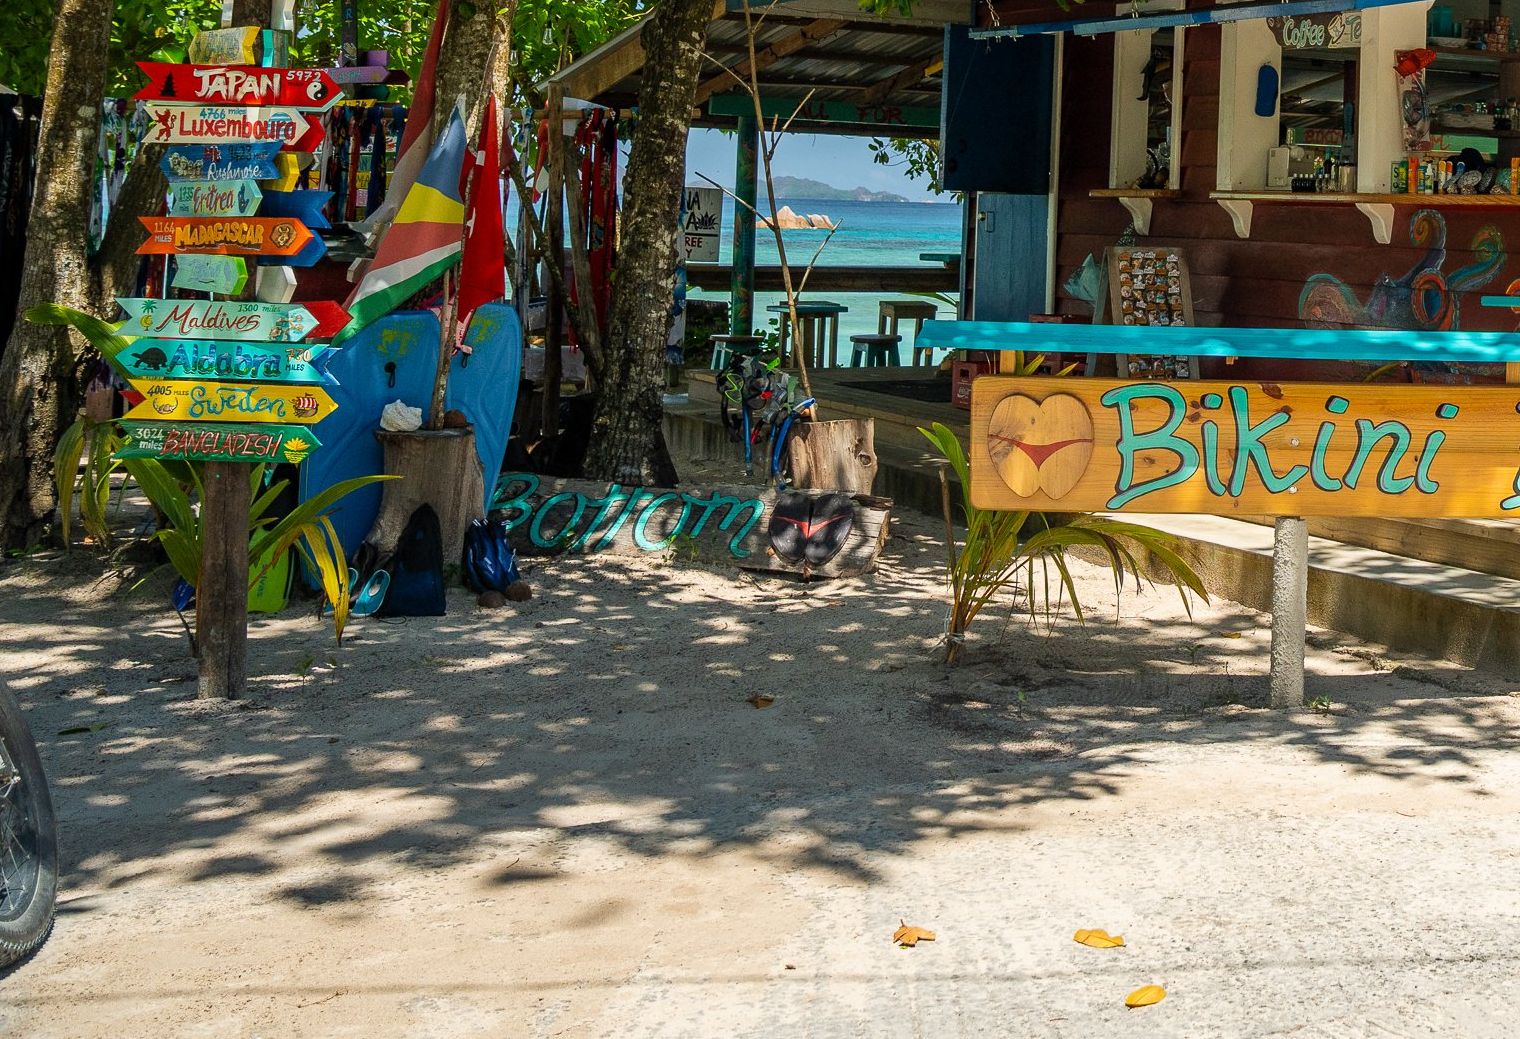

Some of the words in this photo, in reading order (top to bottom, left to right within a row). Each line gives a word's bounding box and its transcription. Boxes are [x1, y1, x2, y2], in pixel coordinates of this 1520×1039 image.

[1282, 18, 1325, 48] Coffee
[1344, 15, 1362, 42] Te
[193, 68, 281, 101] JAPAN
[286, 70, 322, 82] 5972
[179, 110, 297, 141] Luxembourg
[199, 108, 226, 119] 4766
[193, 184, 234, 213] Eritrea
[154, 221, 175, 234] 1164
[154, 235, 173, 243] MILES
[174, 222, 265, 247] MADAGASCAR
[684, 236, 703, 248] REE
[154, 303, 261, 334] Maldives
[238, 303, 259, 312] 1300
[167, 343, 282, 378] Aldabra
[285, 363, 305, 372] MILES
[147, 385, 173, 397] 4005
[188, 385, 287, 419] Sweden
[135, 428, 165, 440] 3024
[139, 439, 164, 451] miles
[161, 428, 284, 457] BANGLADESH
[1100, 381, 1462, 510] Bikini
[489, 471, 766, 559] Bottom
